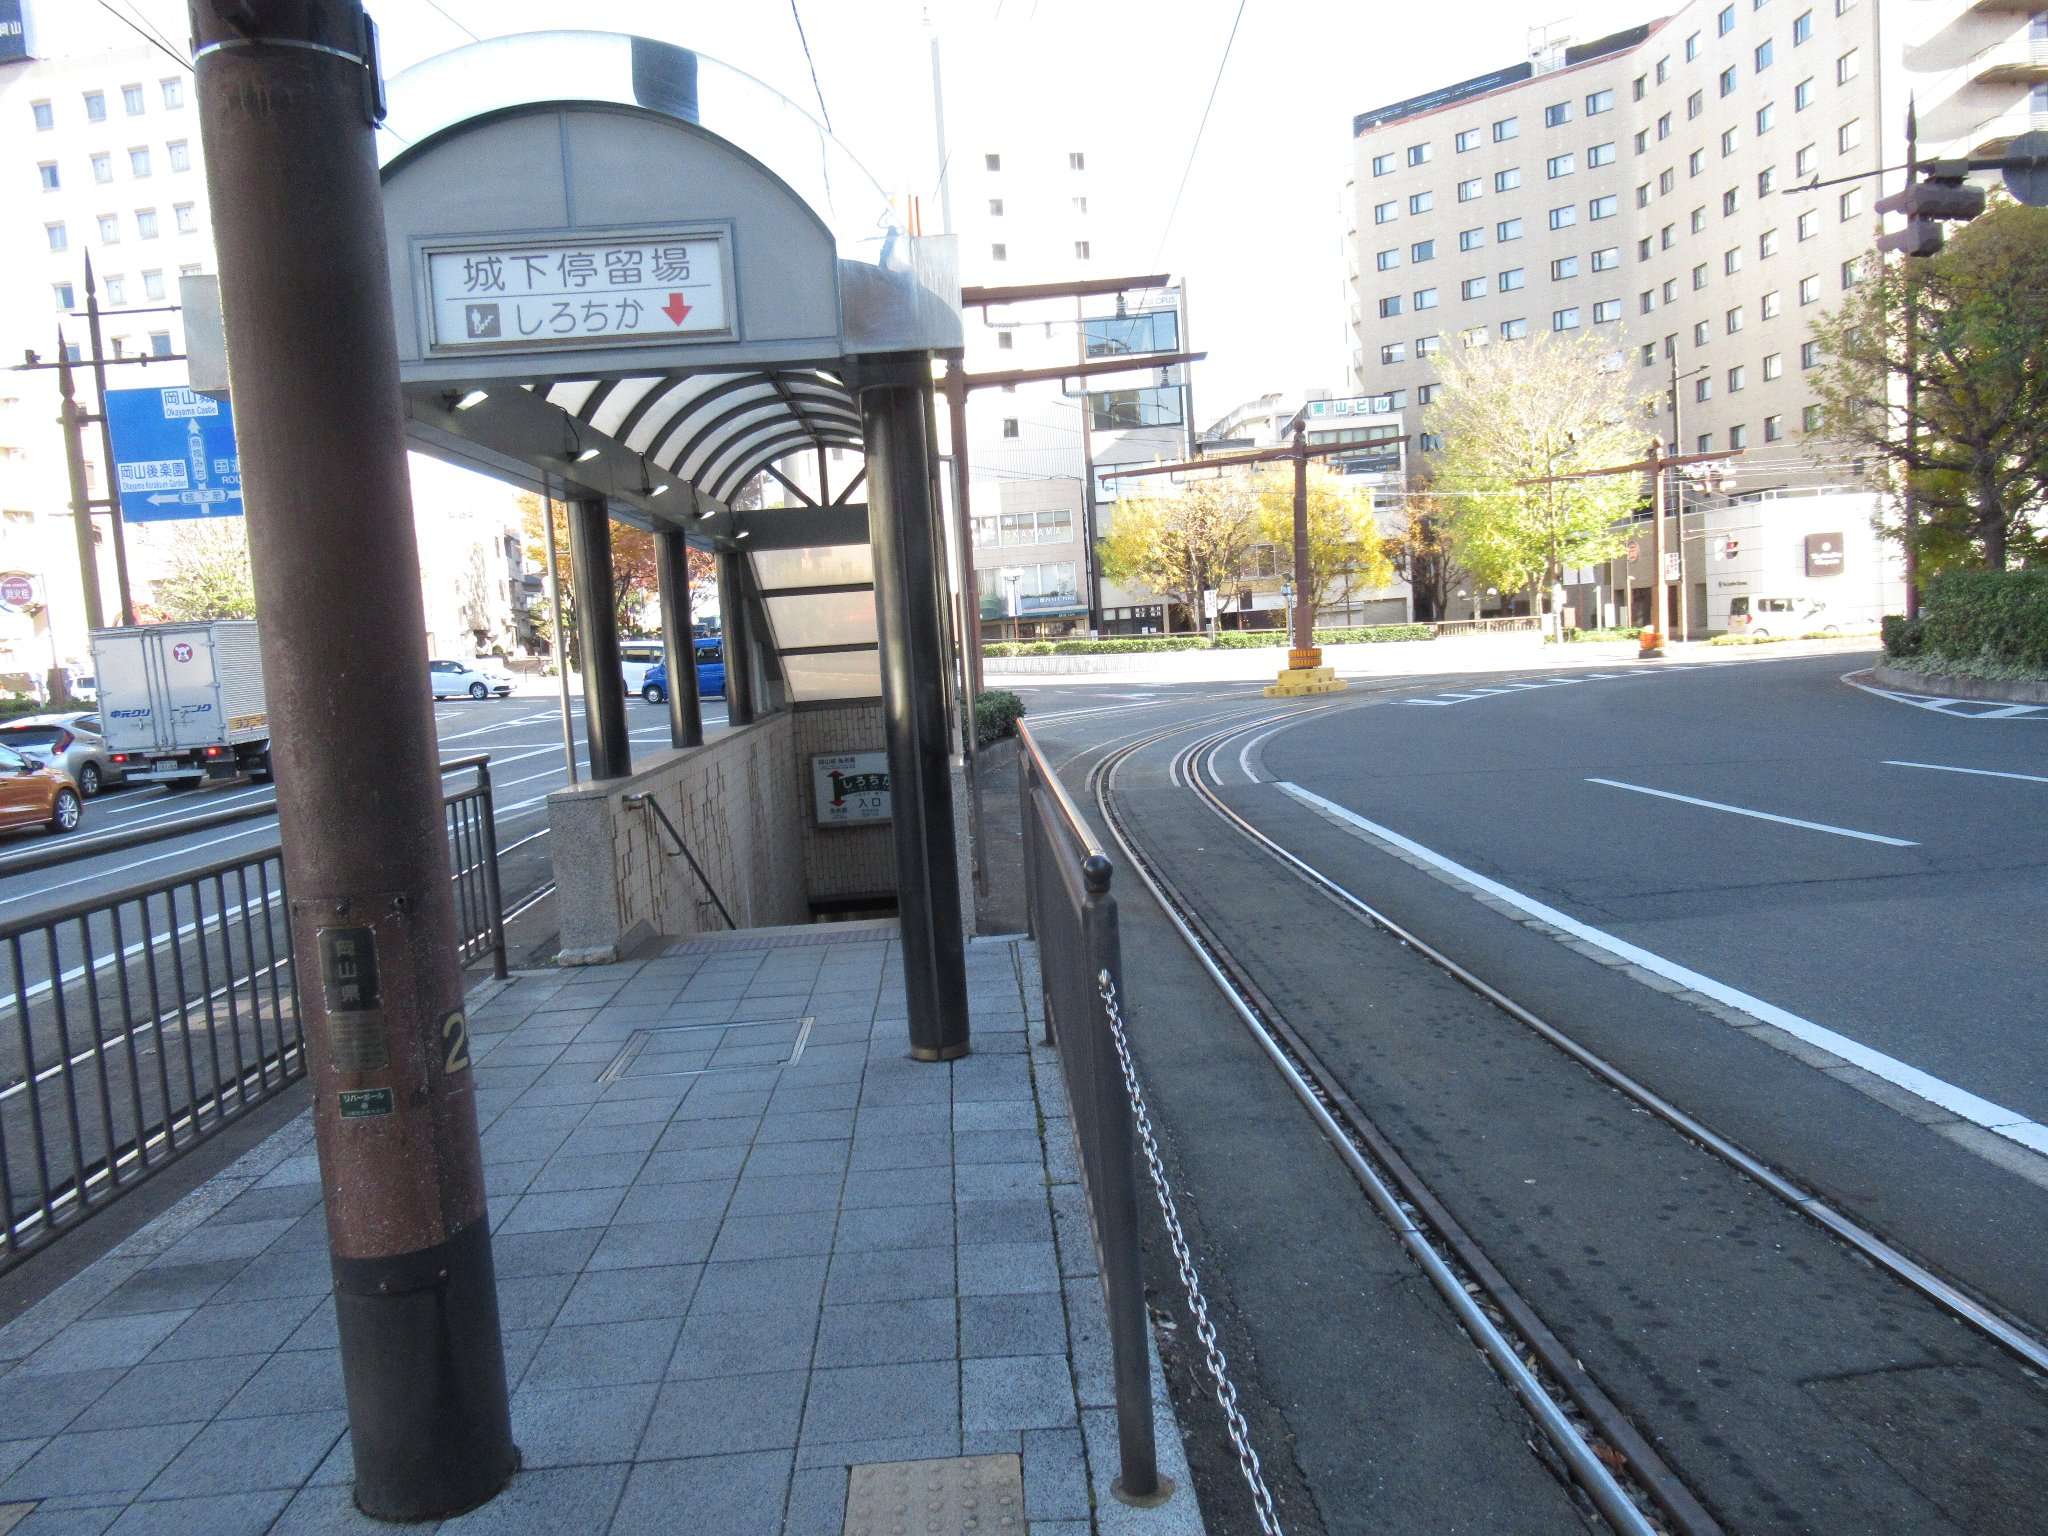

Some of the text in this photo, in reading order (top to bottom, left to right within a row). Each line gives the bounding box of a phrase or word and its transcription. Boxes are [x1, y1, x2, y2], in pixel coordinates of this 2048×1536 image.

[464, 246, 690, 292] 城下停留場
[517, 298, 644, 337] しろちか
[120, 462, 185, 480] 岡山後楽園
[858, 798, 881, 809] 入口
[442, 1012, 469, 1074] 2
